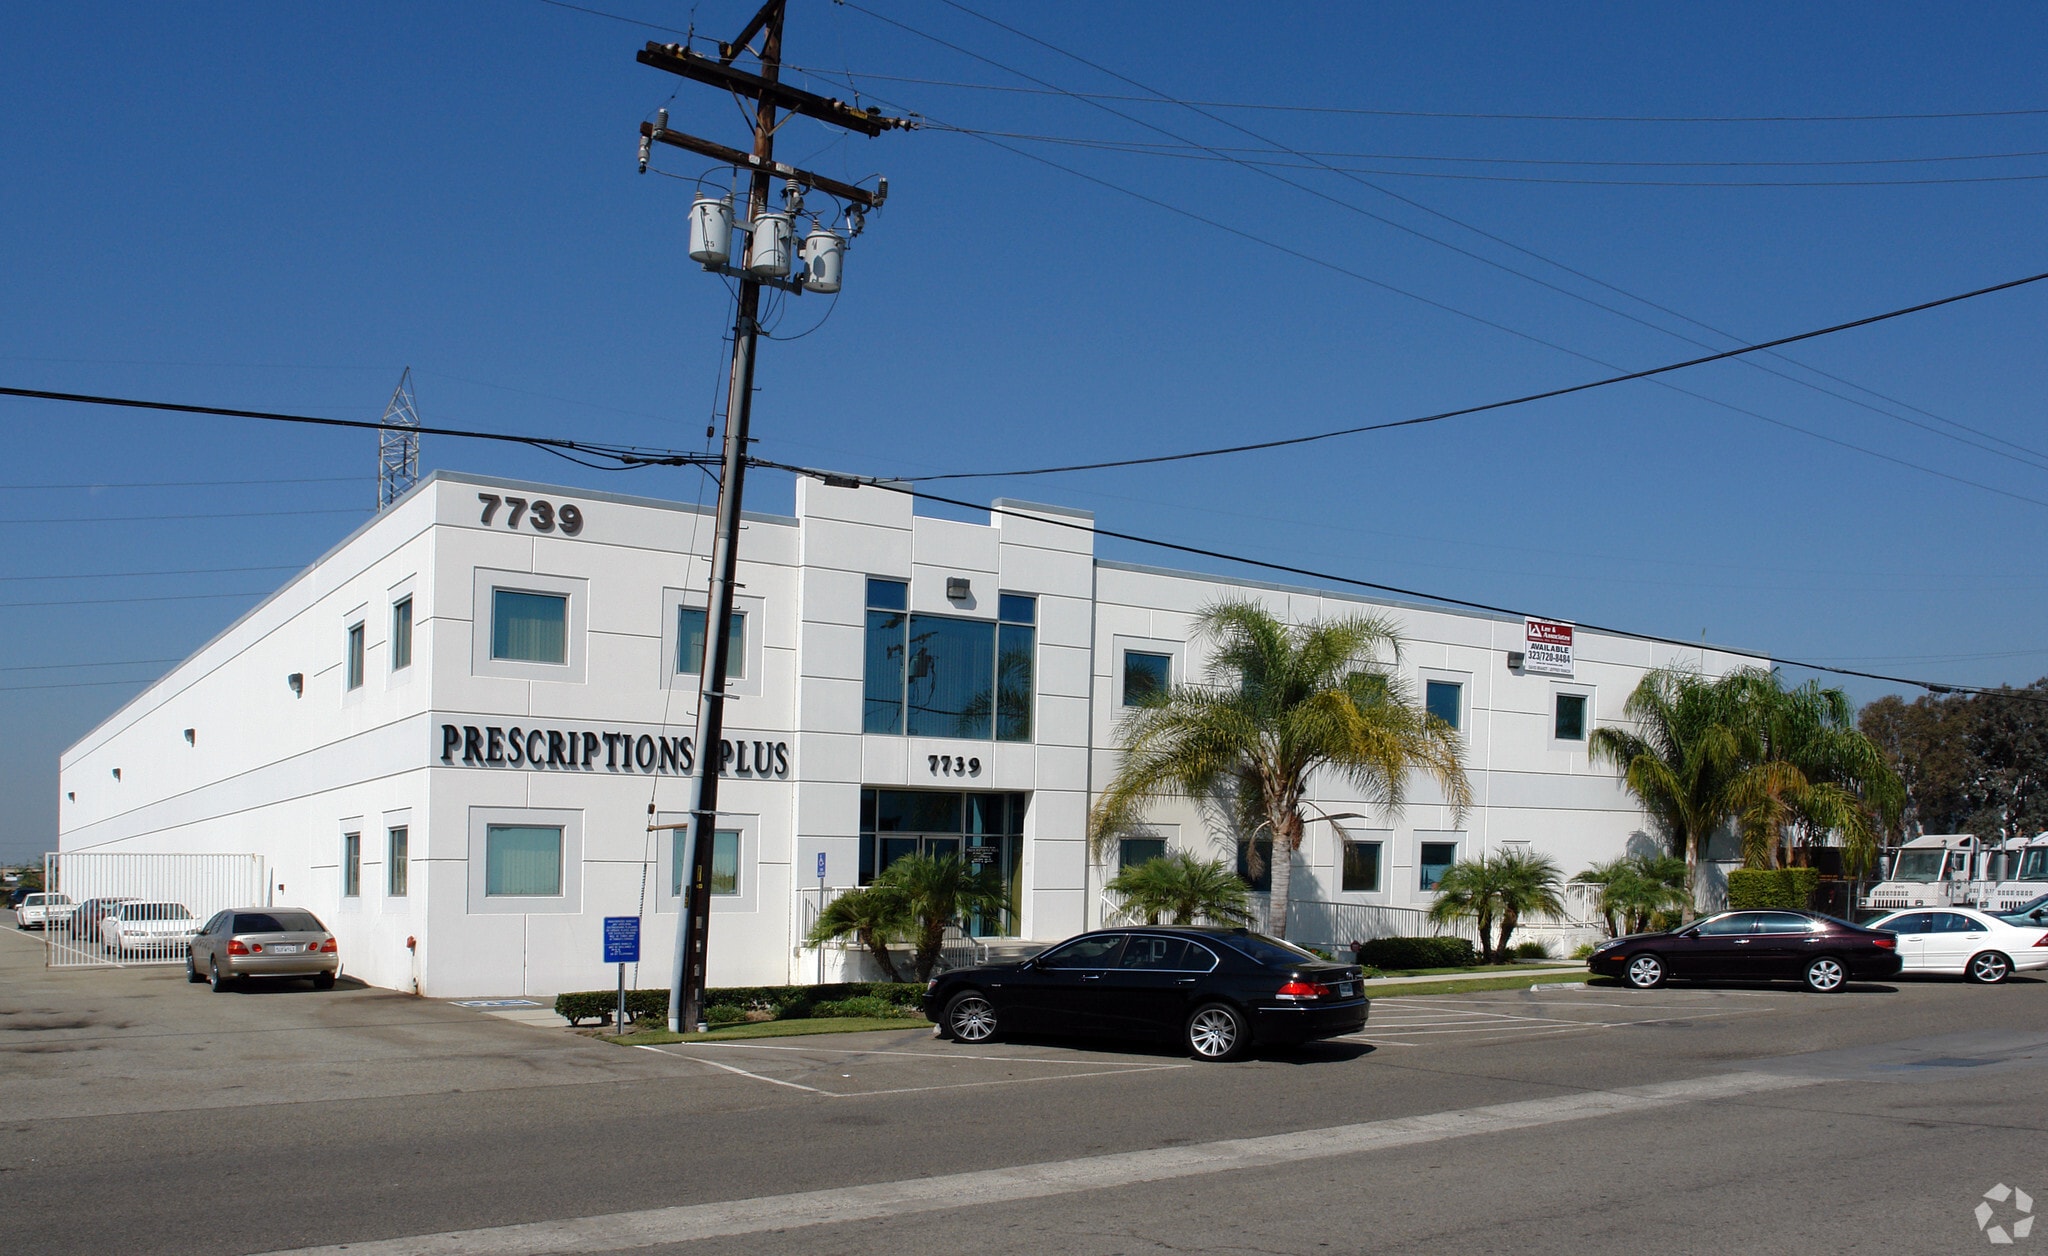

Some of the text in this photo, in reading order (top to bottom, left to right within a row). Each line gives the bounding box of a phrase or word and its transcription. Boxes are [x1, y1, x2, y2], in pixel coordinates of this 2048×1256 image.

[478, 492, 584, 535] 7739
[1530, 643, 1569, 653] AVAILABLE
[440, 723, 789, 776] PRESCRIPTIONS PLUS
[928, 754, 982, 775] 7739
